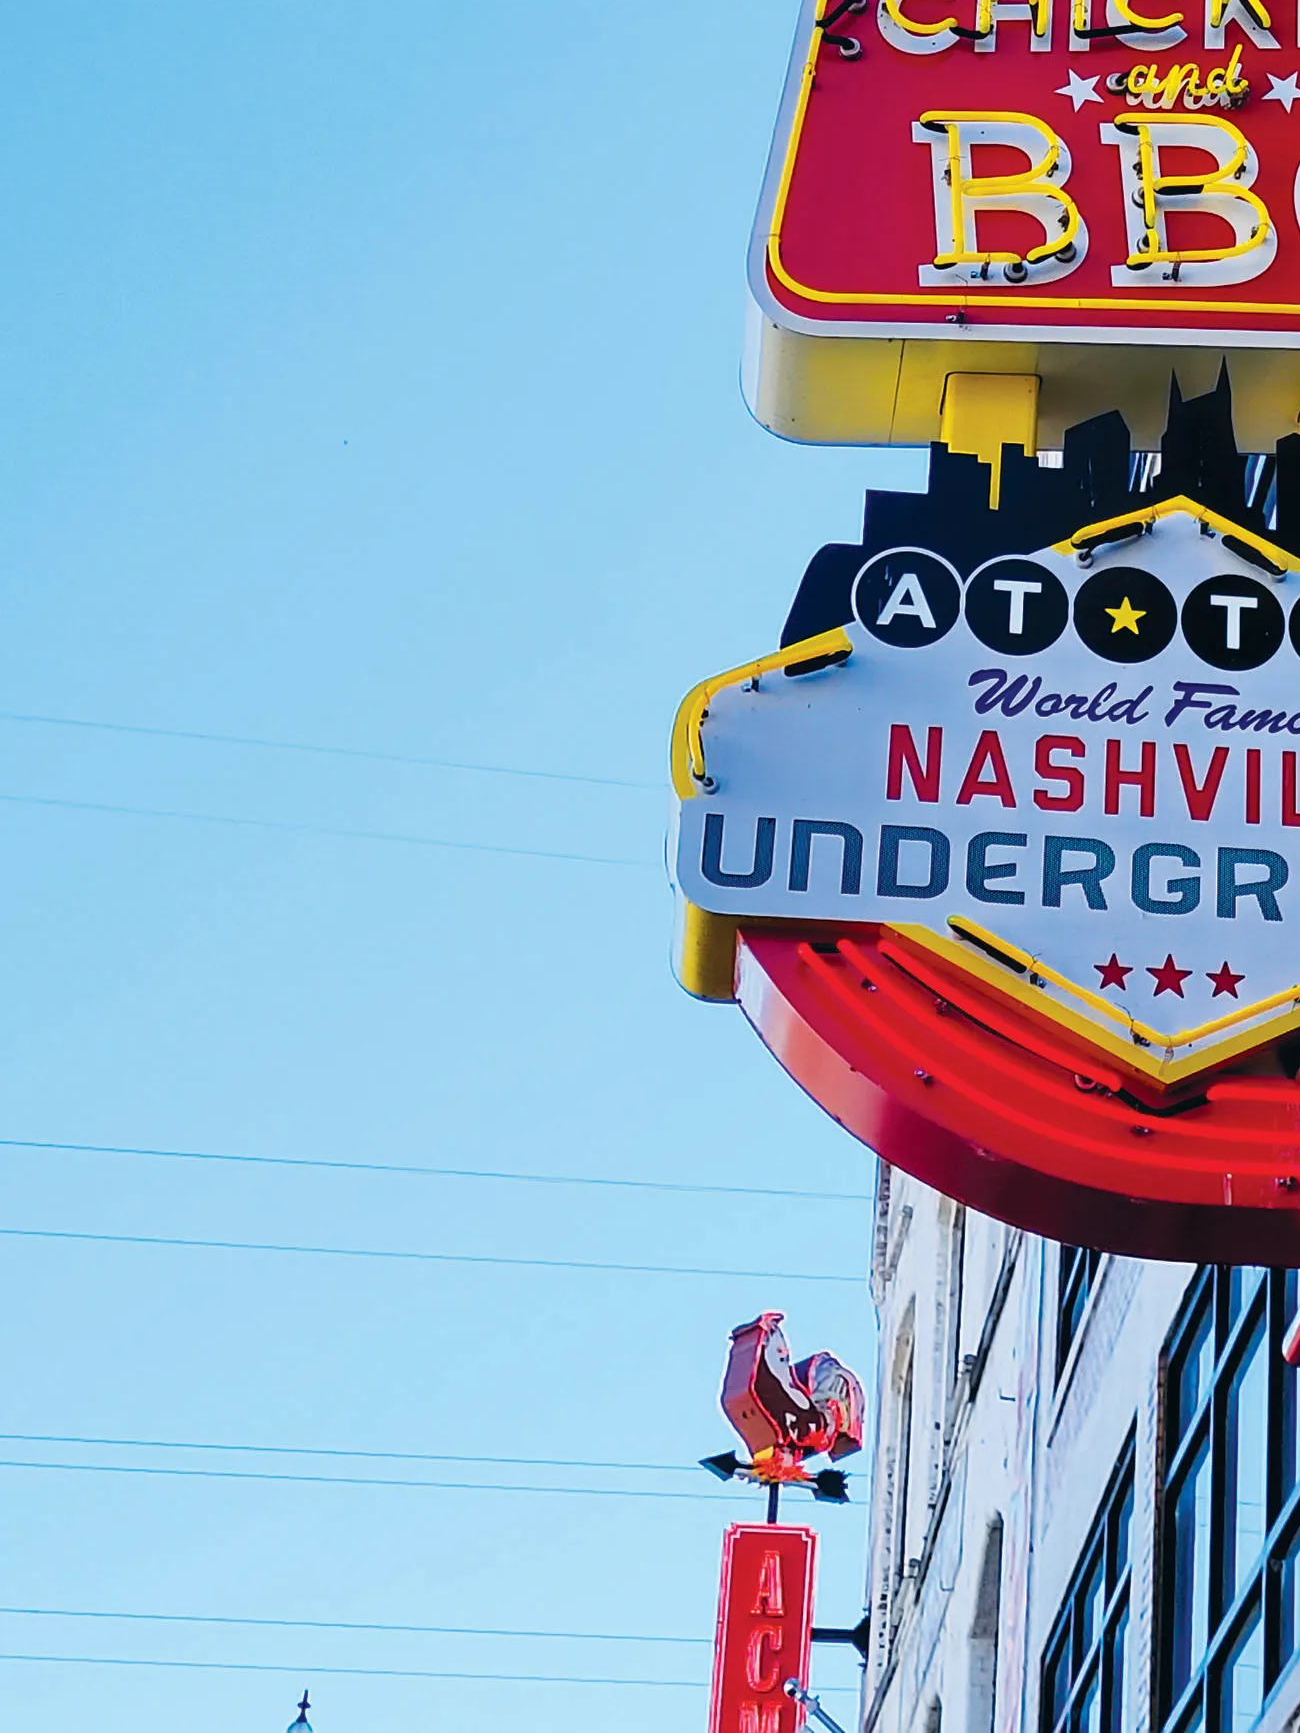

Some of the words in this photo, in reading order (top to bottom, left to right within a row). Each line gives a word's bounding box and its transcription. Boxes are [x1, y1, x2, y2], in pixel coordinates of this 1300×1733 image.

[1122, 43, 1249, 110] and
[874, 572, 1043, 637] AT
[967, 668, 1151, 724] World
